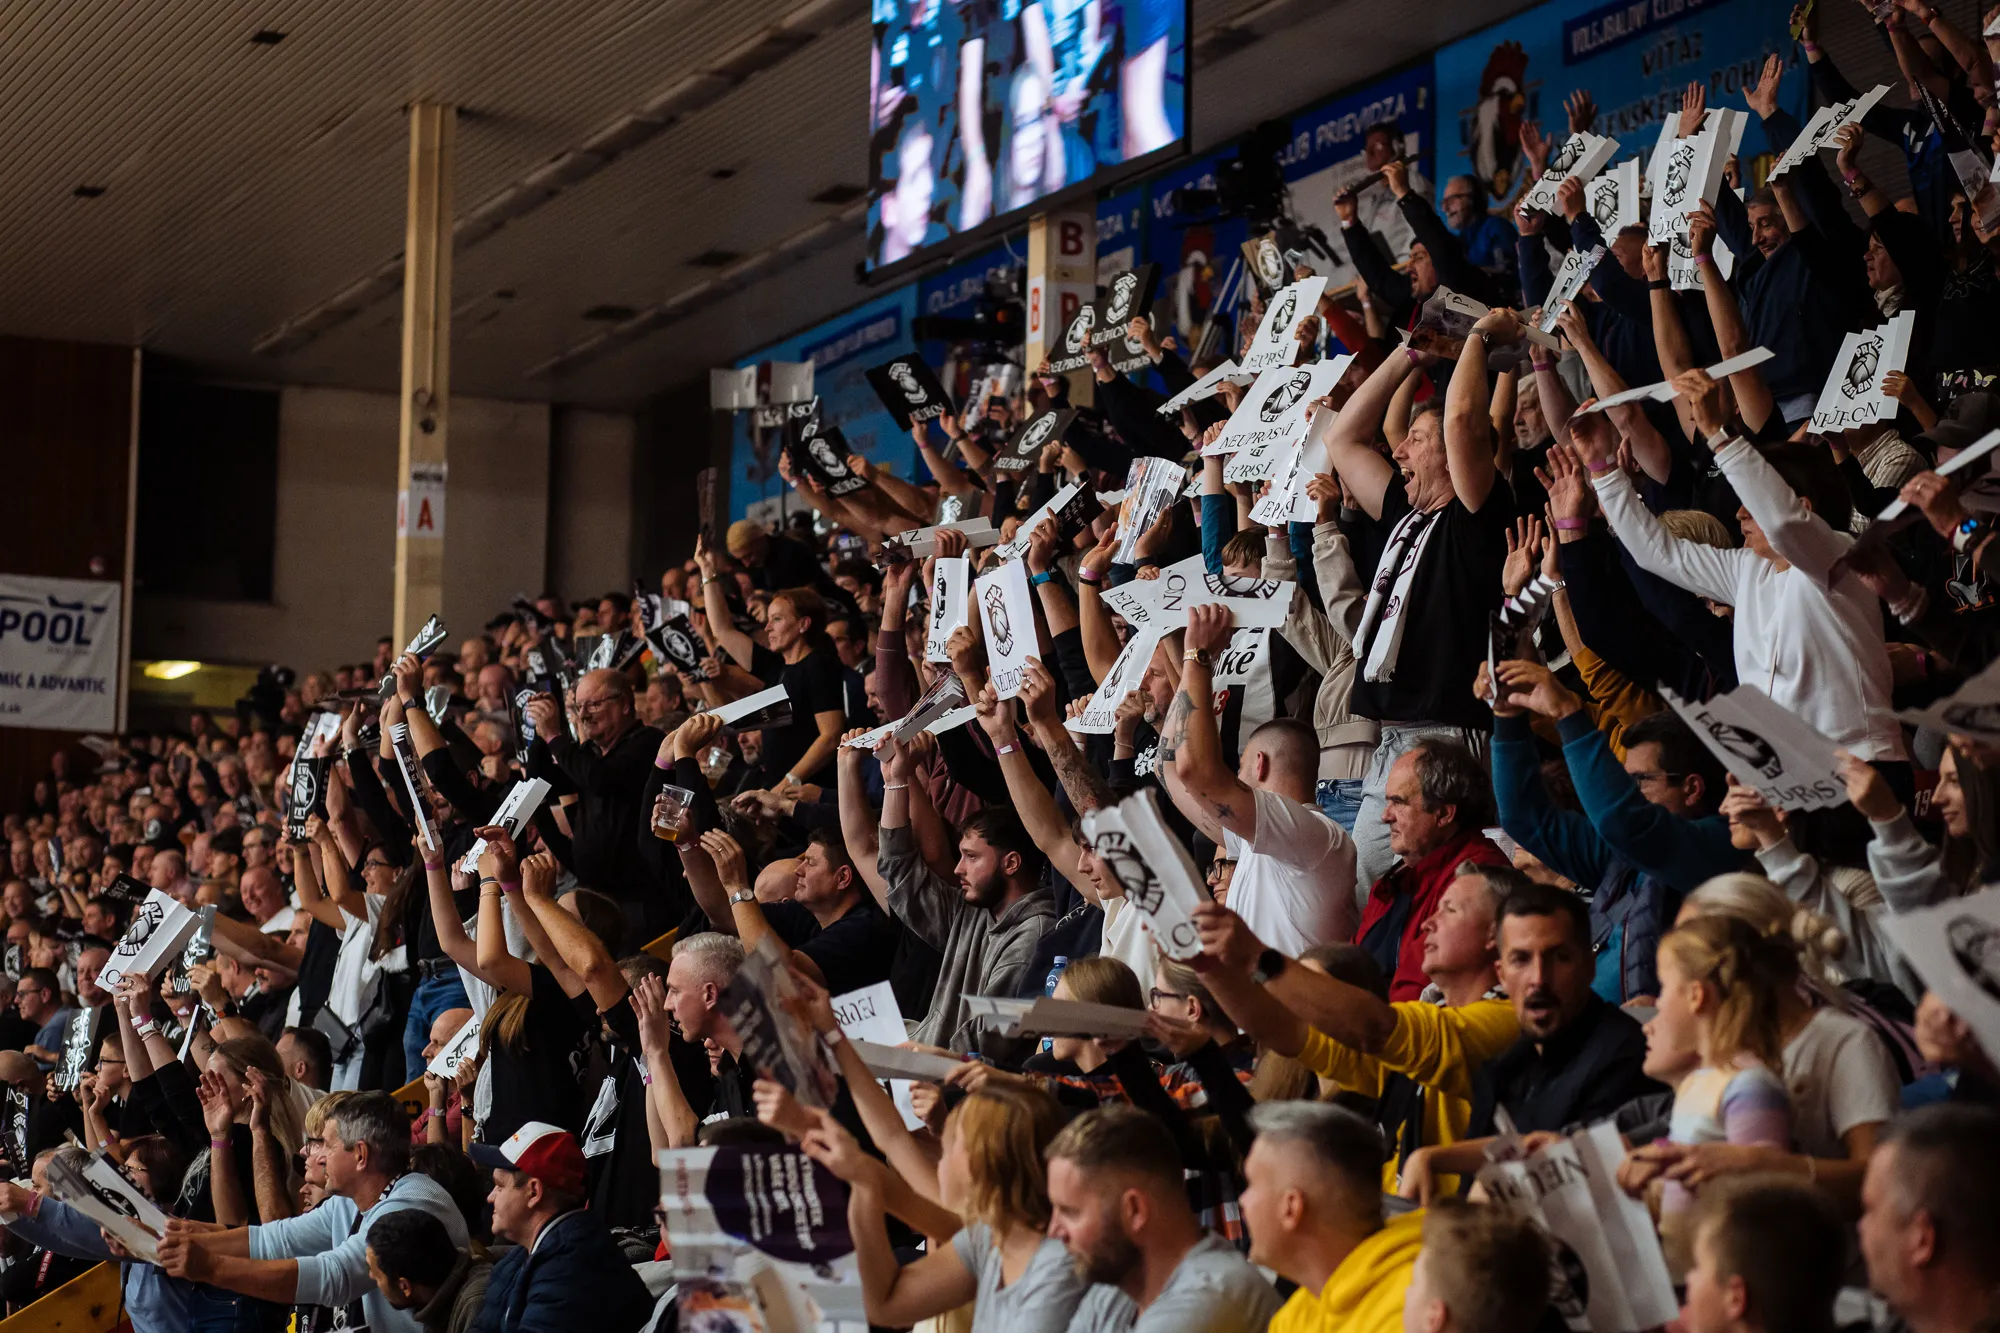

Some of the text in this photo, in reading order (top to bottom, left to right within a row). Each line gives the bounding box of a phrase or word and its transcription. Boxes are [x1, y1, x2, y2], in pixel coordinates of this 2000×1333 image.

[1060, 220, 1083, 256] B
[417, 497, 434, 531] A
[26, 674, 36, 689] A
[39, 674, 107, 695] ADVANTIC
[1914, 788, 1932, 817] 19
